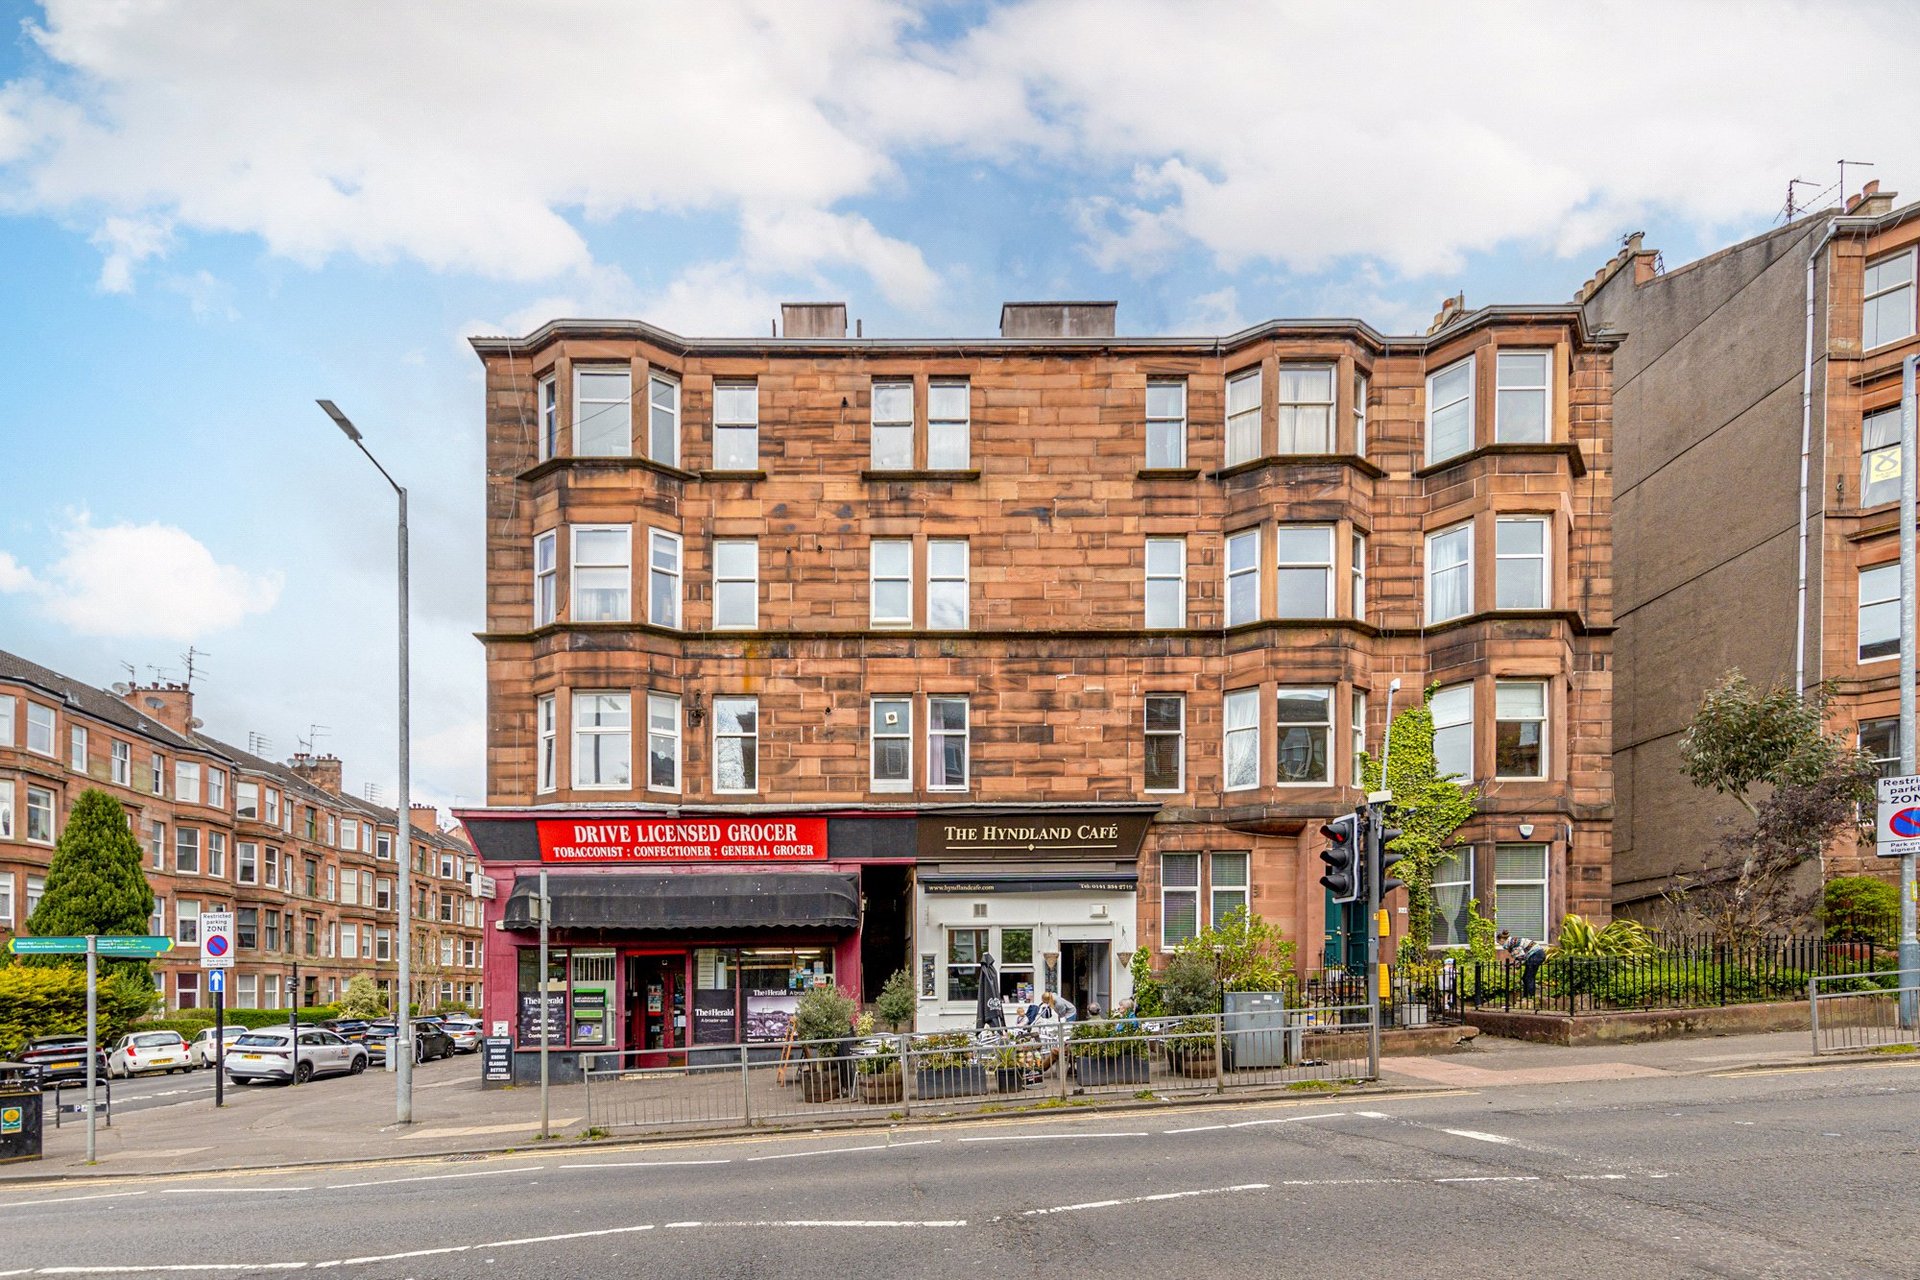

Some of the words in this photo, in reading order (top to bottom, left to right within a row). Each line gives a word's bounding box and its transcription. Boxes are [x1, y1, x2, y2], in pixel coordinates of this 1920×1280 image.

[1883, 777, 1920, 786] Restri
[574, 825, 631, 843] DRIVE
[636, 824, 721, 843] LICENSED
[727, 823, 798, 842] GROCER
[944, 826, 977, 841] THE
[982, 825, 1072, 841] HYNDLAND
[1077, 823, 1118, 840] CAFÉ
[553, 846, 623, 858] TOBACCONIST
[633, 845, 711, 857] CONFECTIONER
[721, 844, 770, 857] GENERAL
[773, 844, 814, 856] GROCER
[928, 884, 995, 892] www.hyndlandcafe.com
[523, 997, 537, 1005] The
